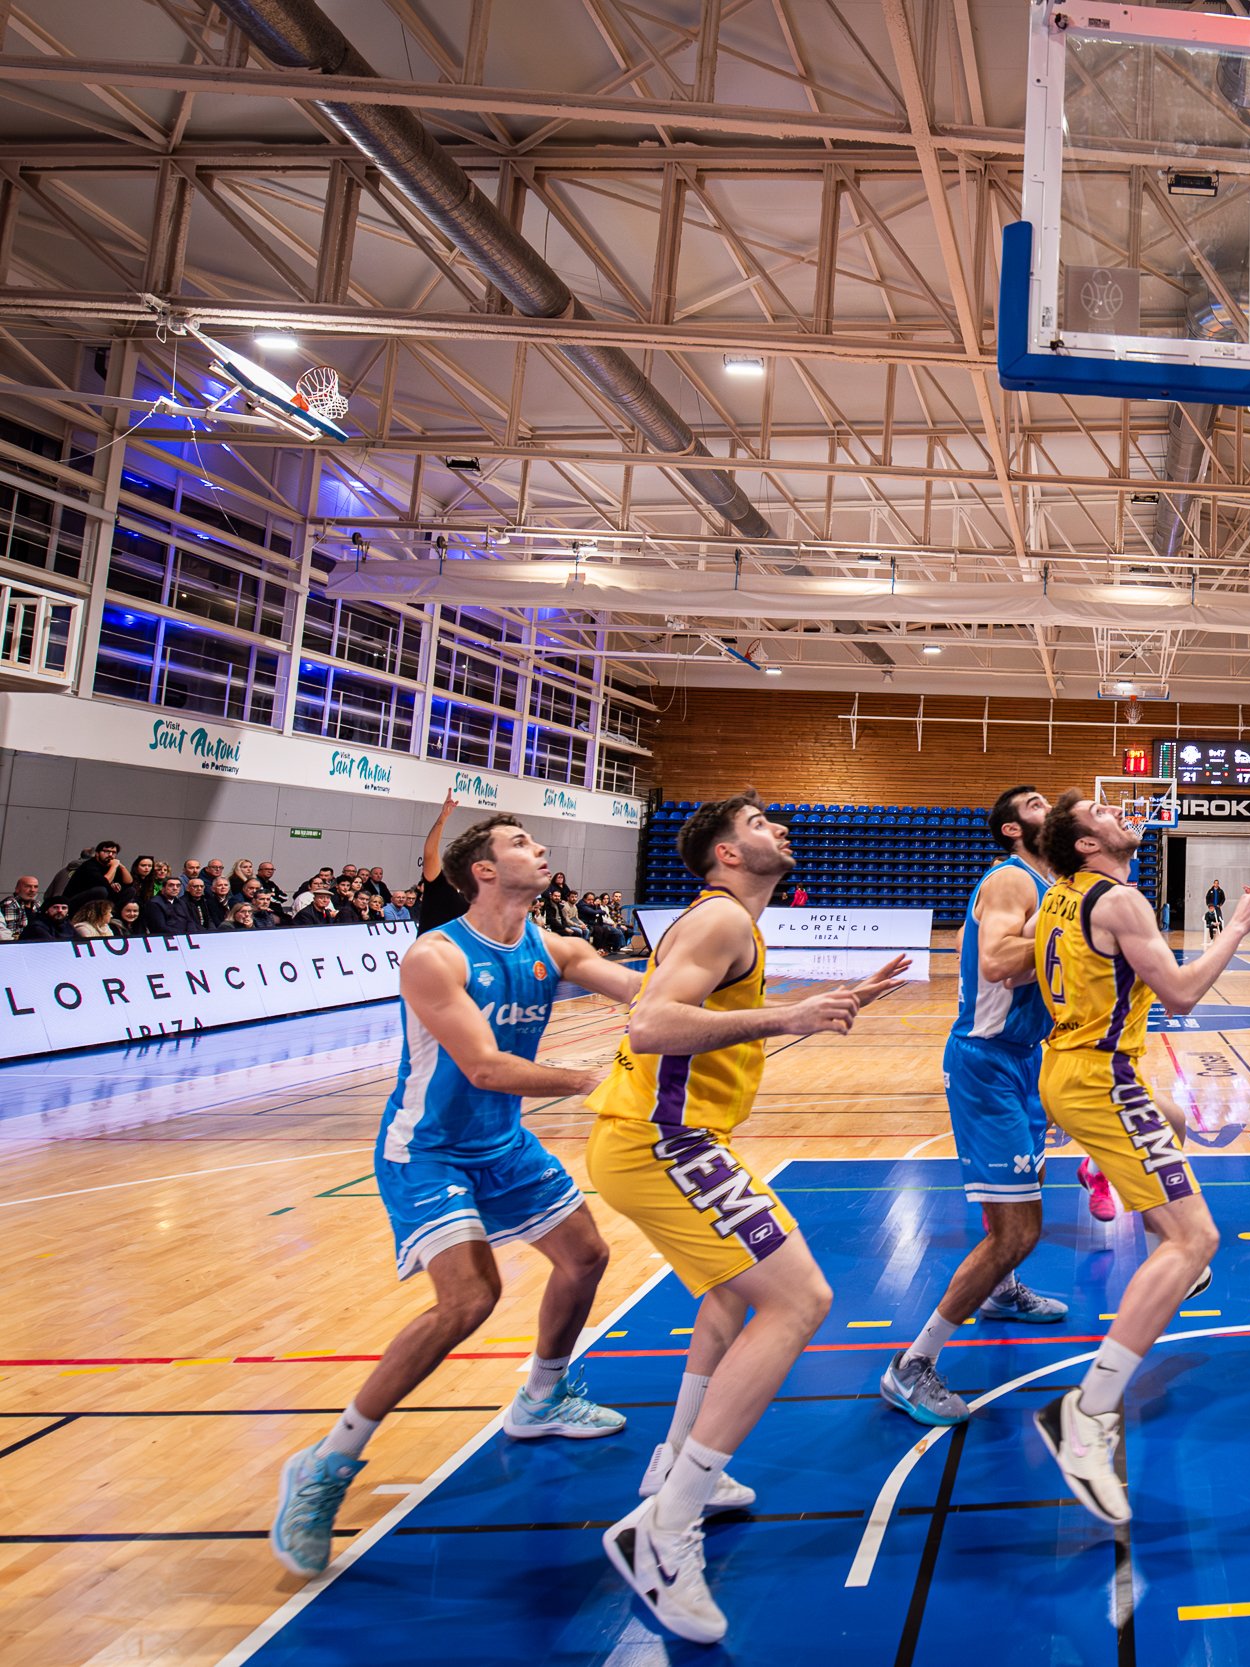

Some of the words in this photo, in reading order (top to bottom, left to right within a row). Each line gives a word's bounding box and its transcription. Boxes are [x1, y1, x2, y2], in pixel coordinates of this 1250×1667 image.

[165, 720, 180, 731] Visit
[149, 719, 188, 755] Sant
[190, 727, 241, 763] Antoni
[340, 752, 351, 760] Visit
[201, 761, 210, 770] de
[210, 762, 240, 775] Portmany
[329, 751, 355, 779] Sant
[356, 756, 392, 784] Antoni
[1183, 772, 1197, 782] 21
[1237, 773, 1250, 783] 17
[453, 771, 472, 795] Sant
[473, 775, 499, 799] Antoni
[778, 924, 879, 932] FLORENCIO
[1044, 927, 1066, 1005] 6
[1109, 1084, 1187, 1175] UEM
